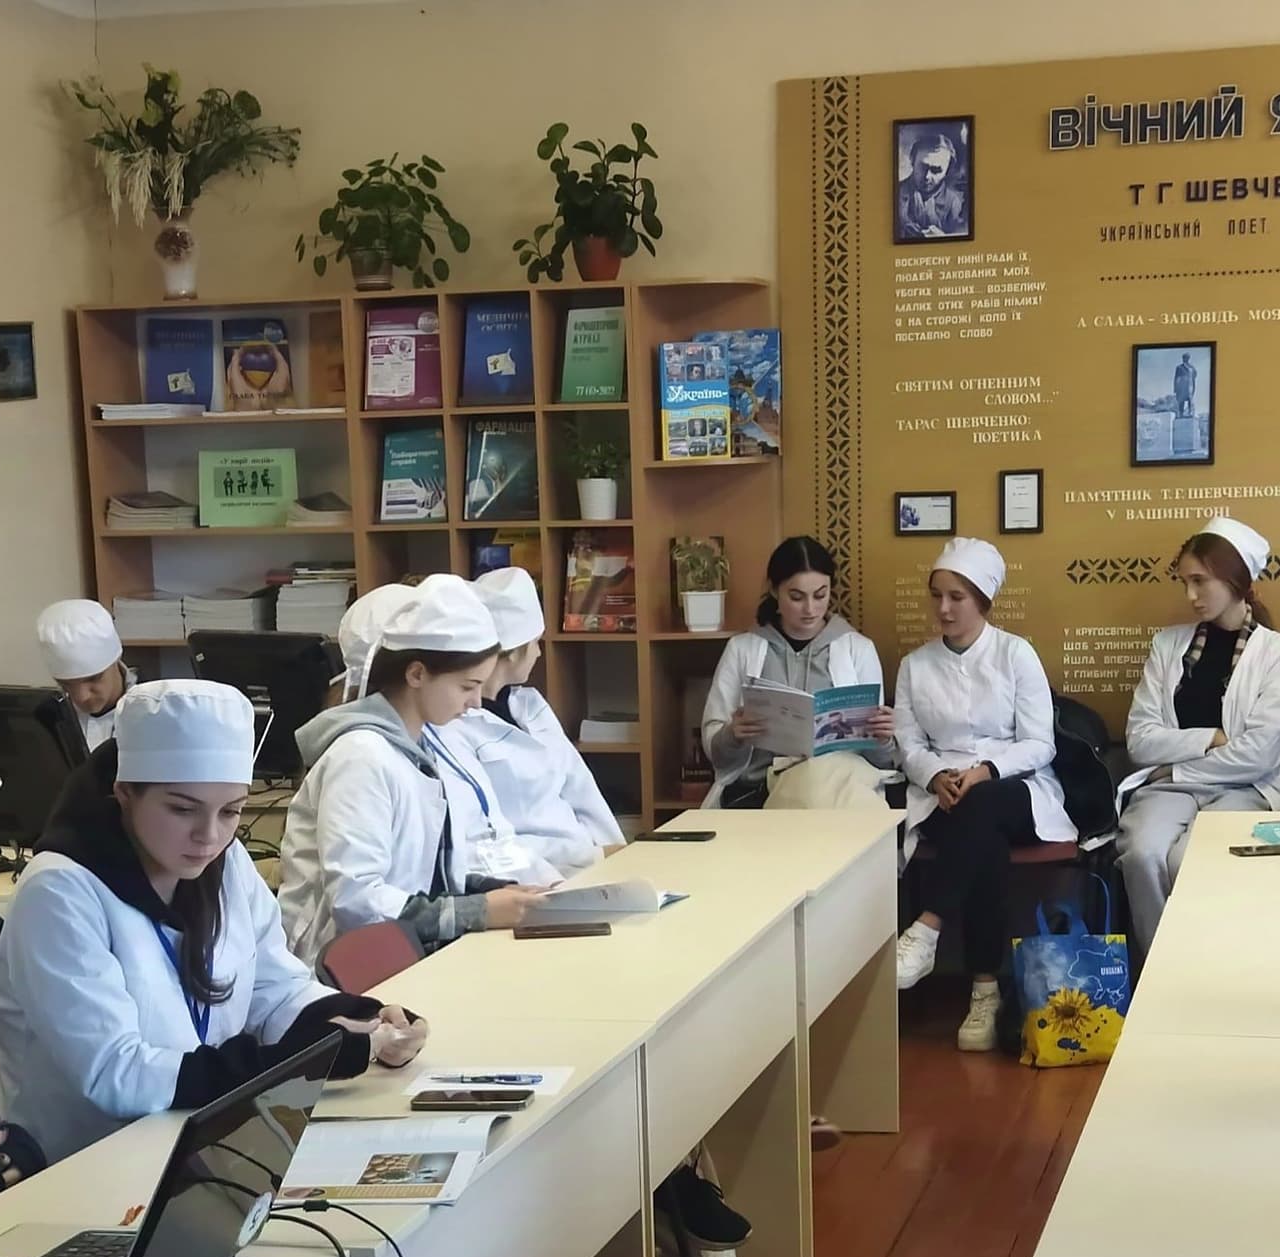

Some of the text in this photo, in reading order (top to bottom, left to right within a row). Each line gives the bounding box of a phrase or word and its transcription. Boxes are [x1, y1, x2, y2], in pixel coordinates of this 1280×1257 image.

[1049, 84, 1245, 150] ВІЧНИЙ
[1100, 218, 1201, 242] УКРАЇНСЬКИЙ
[895, 256, 951, 268] ВОСКРЕСНУ
[986, 252, 1014, 263] РАДИ
[895, 270, 933, 282] ЛЮДЕЙ
[939, 268, 997, 280] ЗАКОВАНИХ
[895, 287, 932, 297] УБОГИХ
[895, 302, 932, 313] МАЛИХ
[938, 300, 964, 310] ОТИХ
[970, 298, 1000, 309] РАБІВ
[908, 316, 922, 326] НА
[926, 314, 972, 326] СТОРОЖІ
[979, 312, 1007, 323] КОЛО
[1093, 315, 1144, 327] СЛАВА
[1160, 310, 1239, 325] ЗАПОВІДЬ
[895, 331, 951, 342] ПОСТАВЛЮ
[959, 376, 1041, 390] ОГНЕННИМ
[895, 418, 940, 431] ТАРАС
[973, 429, 1042, 444] ПОЕТИКА
[1126, 506, 1231, 521] ВАШИНГТОНІ
[1075, 624, 1142, 636] КРУГОСВІТНІЙ
[1074, 669, 1119, 679] ГЛИБИНУ
